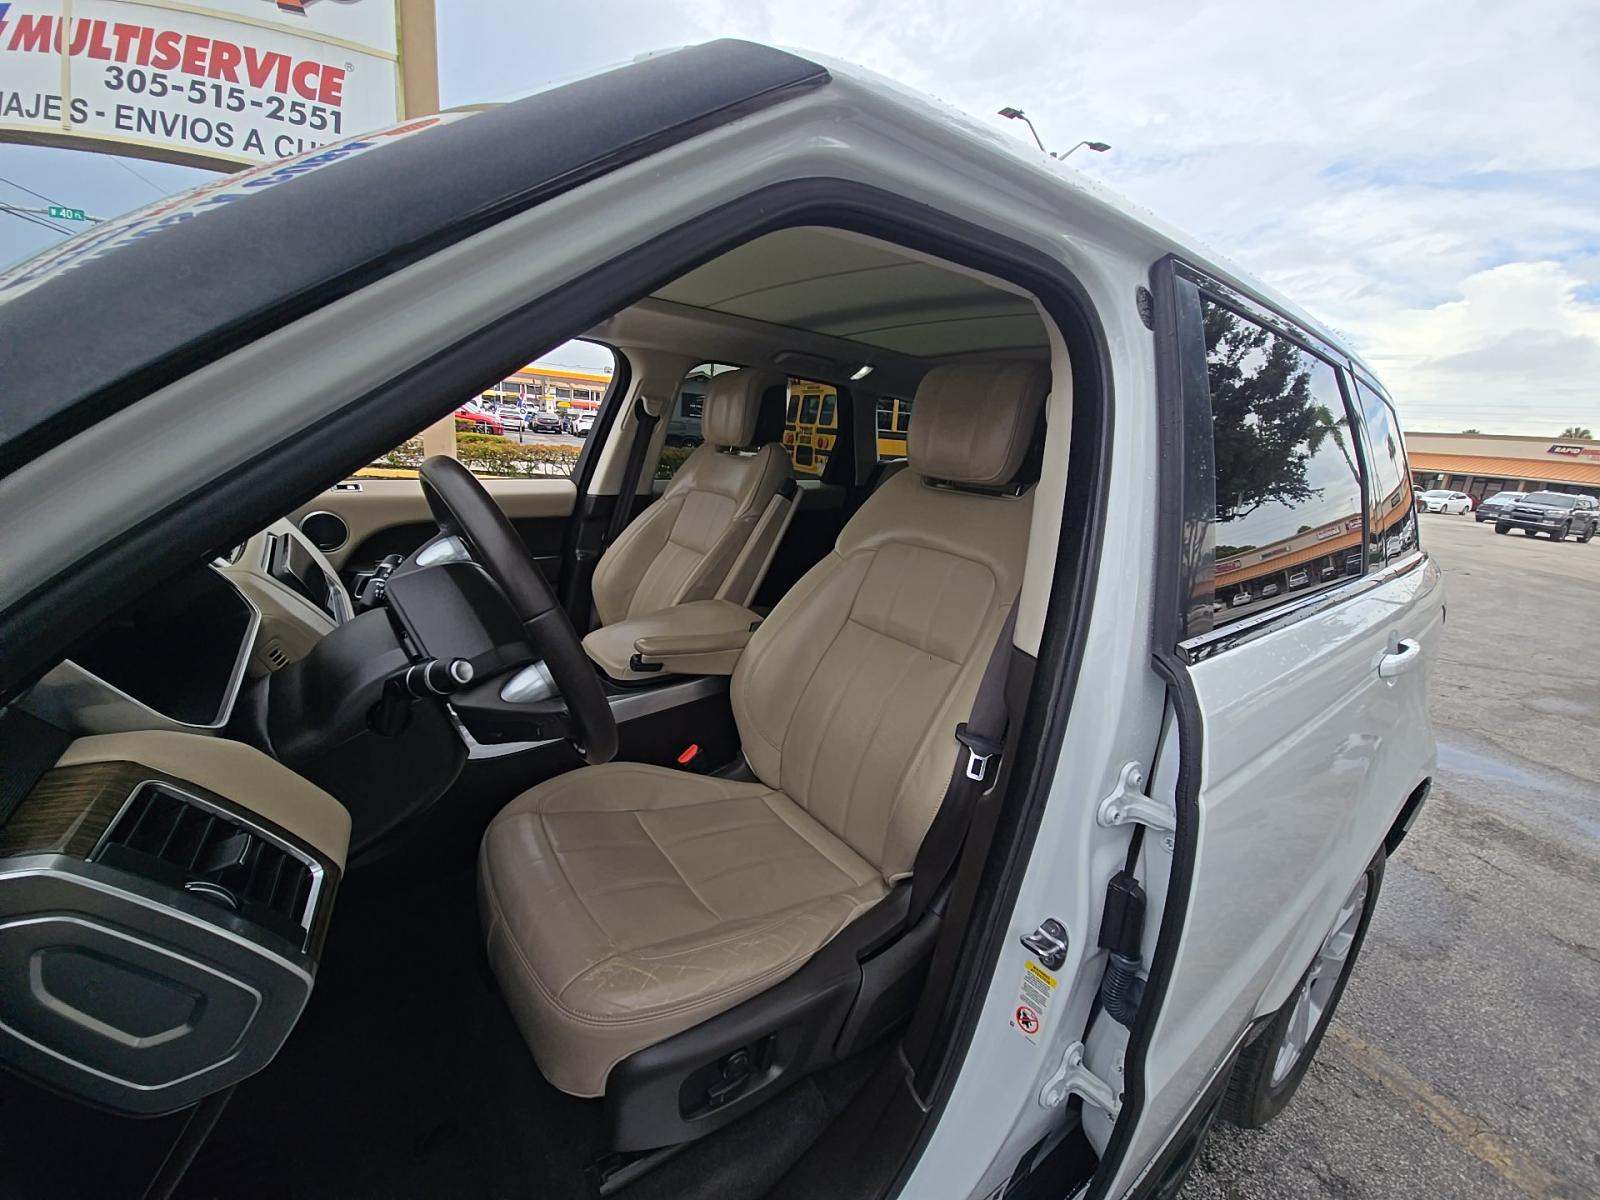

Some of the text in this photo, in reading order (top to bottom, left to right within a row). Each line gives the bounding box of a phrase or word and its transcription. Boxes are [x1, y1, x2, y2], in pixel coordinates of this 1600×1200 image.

[7, 14, 346, 107] MULTISERVICE
[104, 66, 342, 134] 305-515-2551
[115, 104, 234, 148] ENVIOS
[243, 128, 266, 155] A
[60, 209, 73, 219] 40
